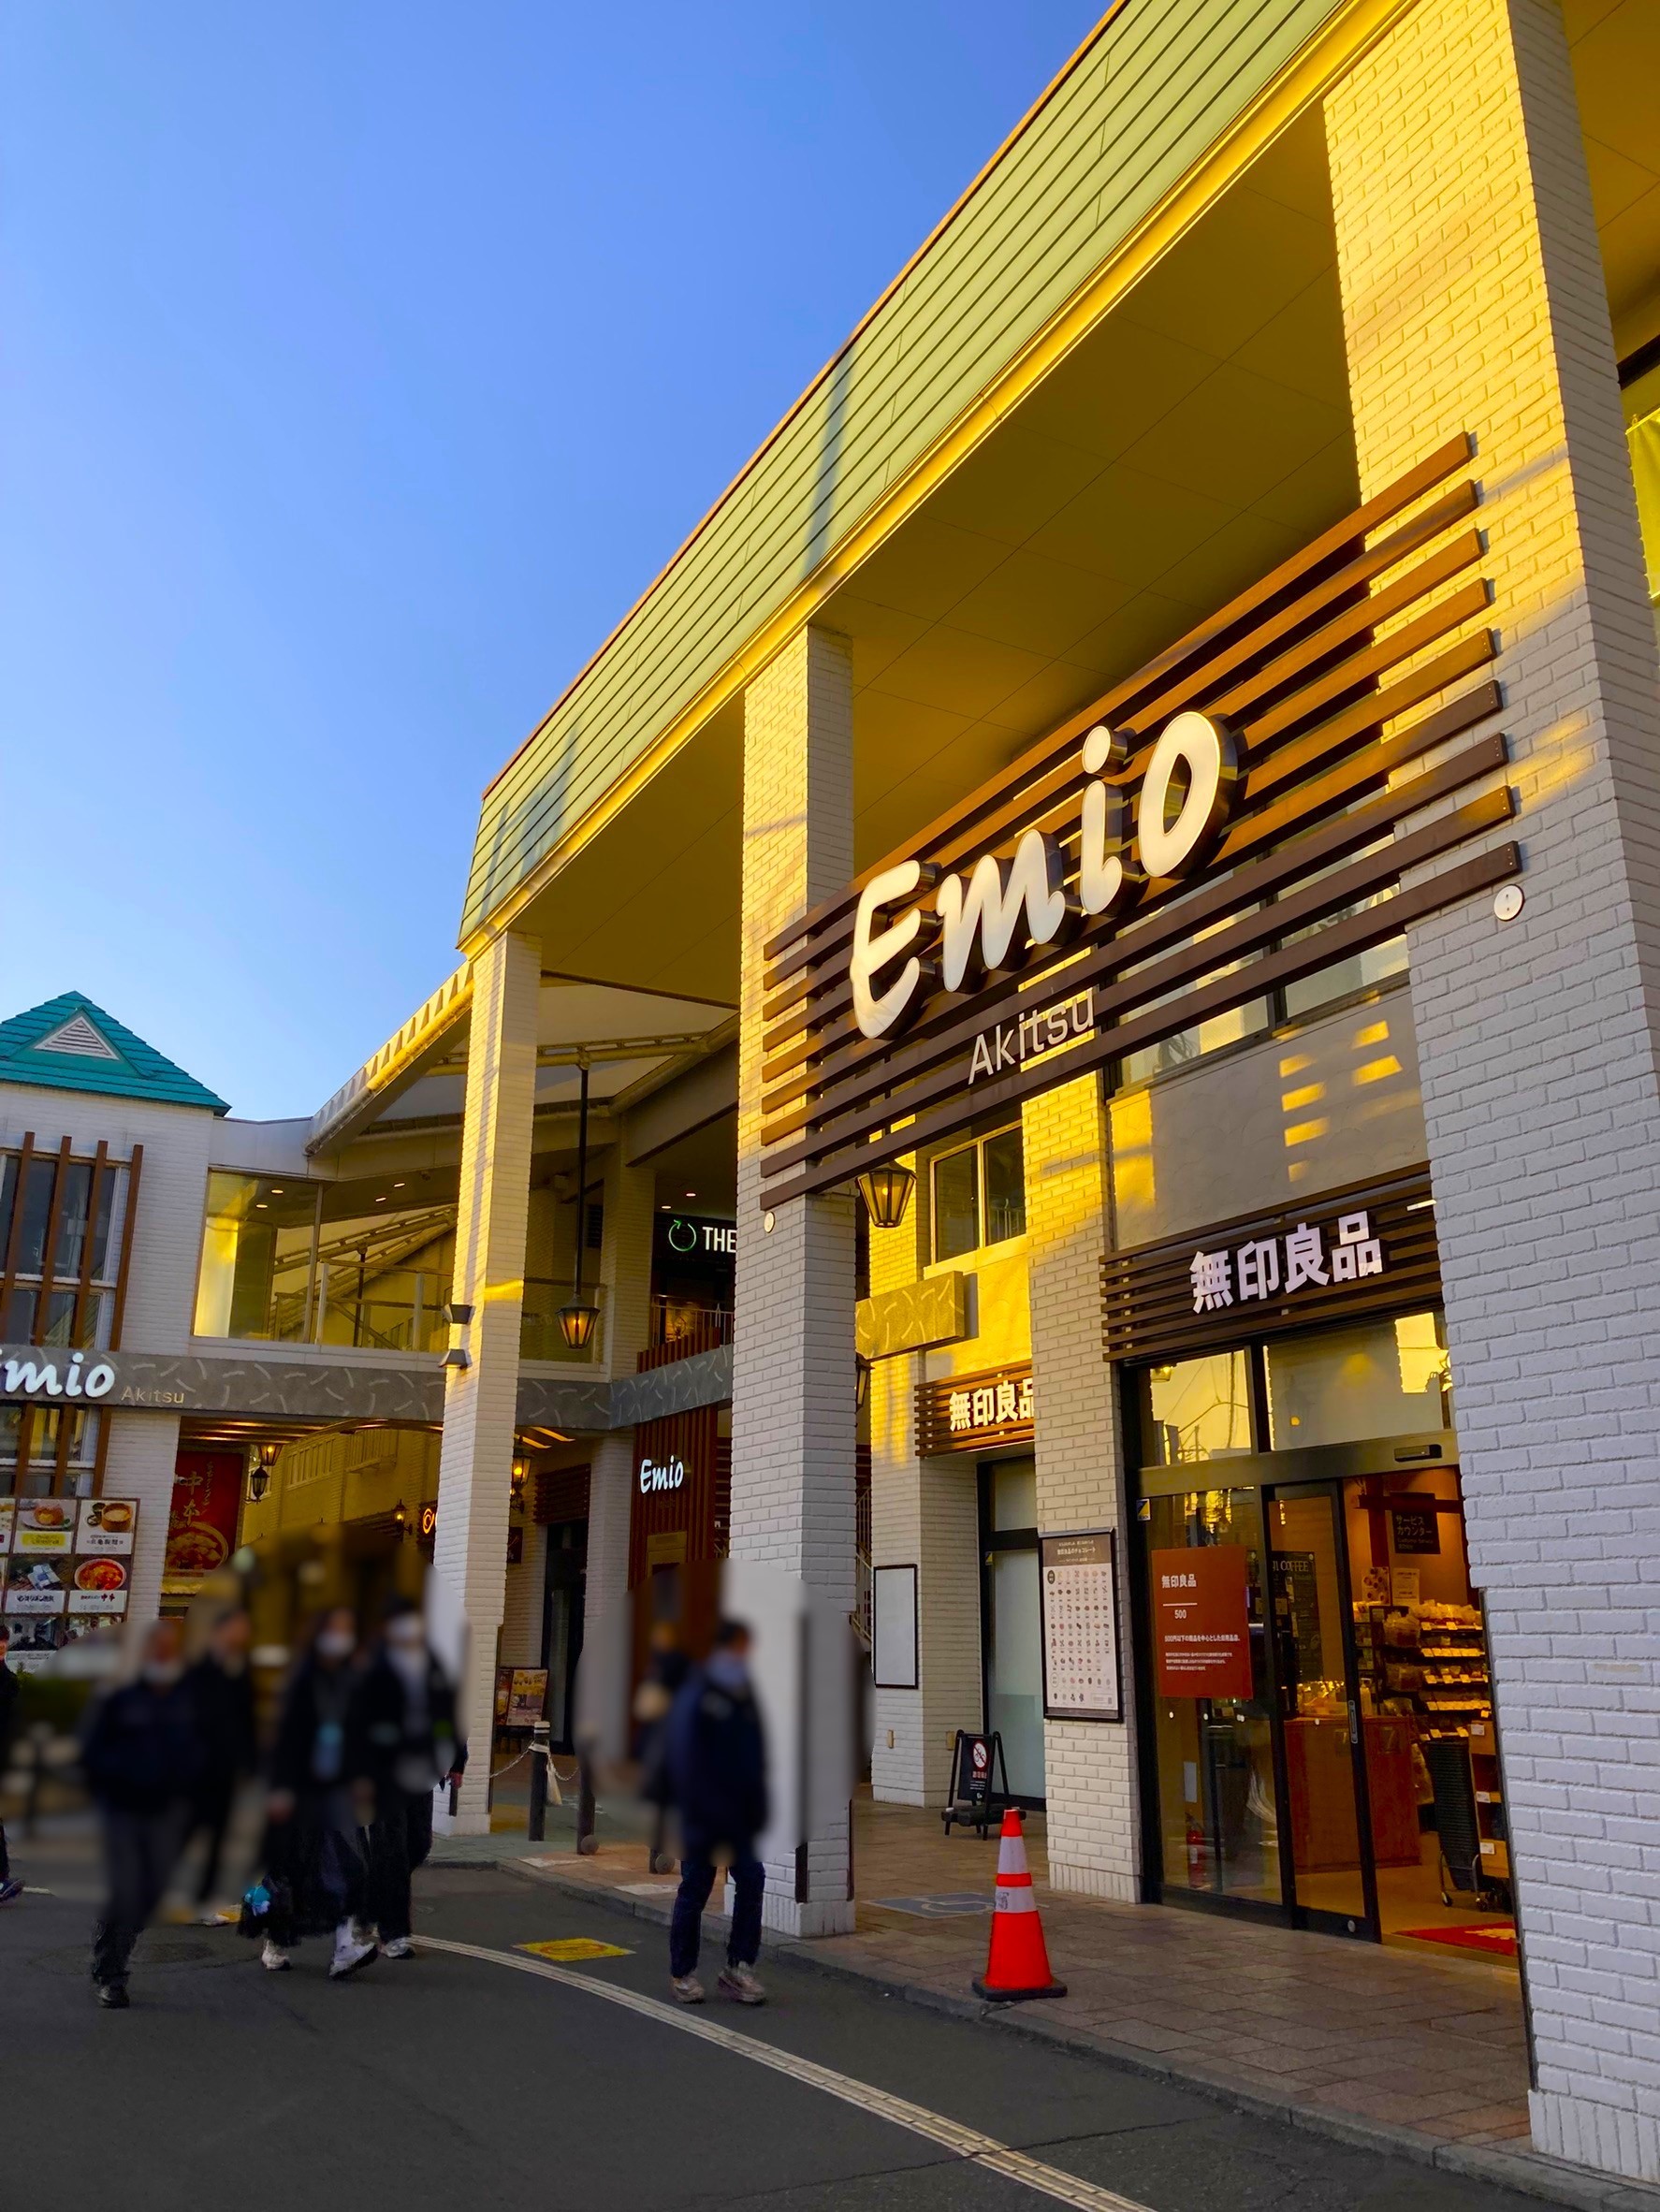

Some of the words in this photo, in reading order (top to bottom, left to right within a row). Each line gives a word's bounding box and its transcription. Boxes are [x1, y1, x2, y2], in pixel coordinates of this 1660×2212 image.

[850, 711, 1221, 1040] Emio
[968, 986, 1095, 1085] Akitsu
[702, 1227, 736, 1253] THE
[1189, 1211, 1383, 1314] 無印良品
[0, 1349, 115, 1398] mio
[121, 1386, 185, 1404] Akitsu
[949, 1377, 1034, 1432] 無印良品
[639, 1455, 684, 1494] Emio
[1161, 1574, 1197, 1589] 無印良品
[1174, 1609, 1187, 1620] 500
